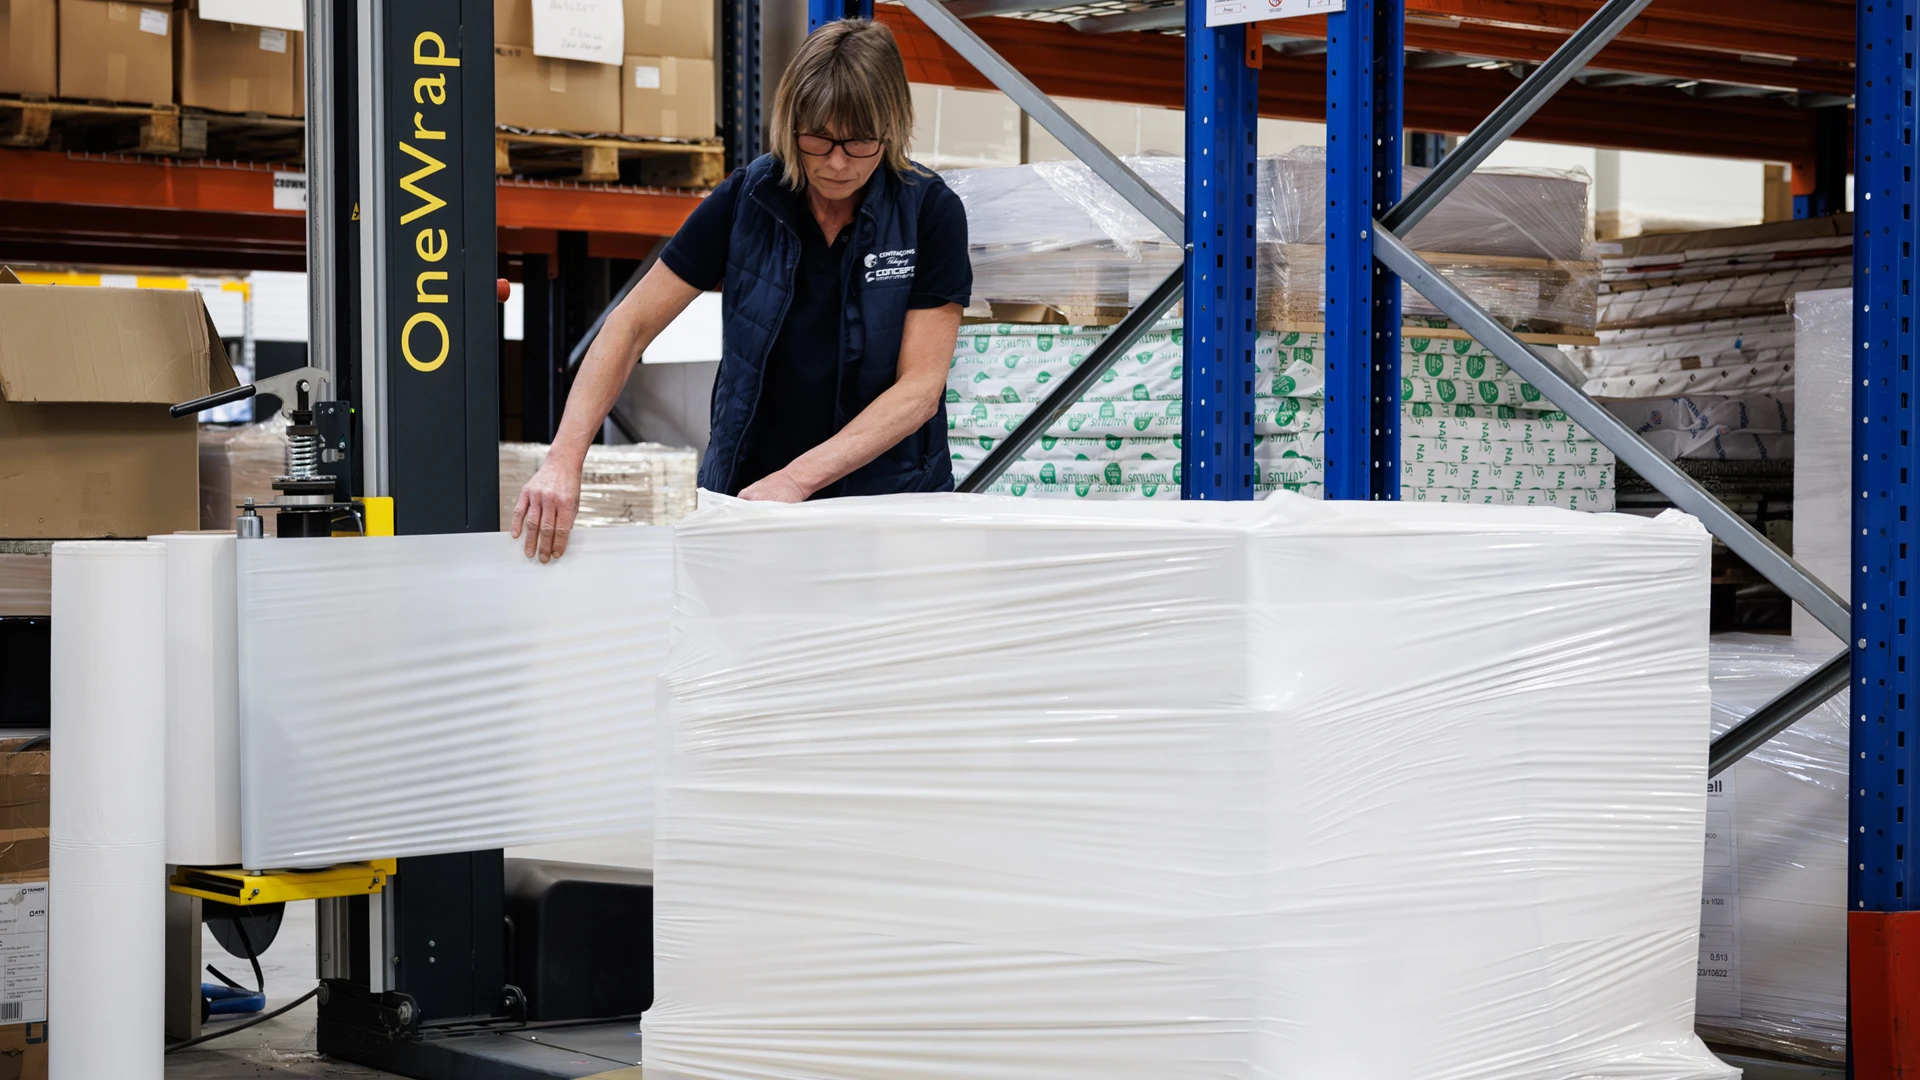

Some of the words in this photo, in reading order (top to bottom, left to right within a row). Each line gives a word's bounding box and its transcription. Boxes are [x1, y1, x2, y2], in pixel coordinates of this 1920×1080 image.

[274, 178, 306, 188] CROWN
[399, 30, 460, 372] OneWrap
[876, 266, 916, 276] CONCEPT
[1060, 337, 1096, 346] NAUTILUS
[1140, 333, 1166, 344] NAUTI
[1001, 474, 1035, 483] NAUTILUS
[1062, 474, 1100, 482] NAUTILUS
[1128, 474, 1167, 482] NAUTILUS
[1097, 484, 1136, 492] NAUTILUS
[1707, 780, 1722, 792] ell
